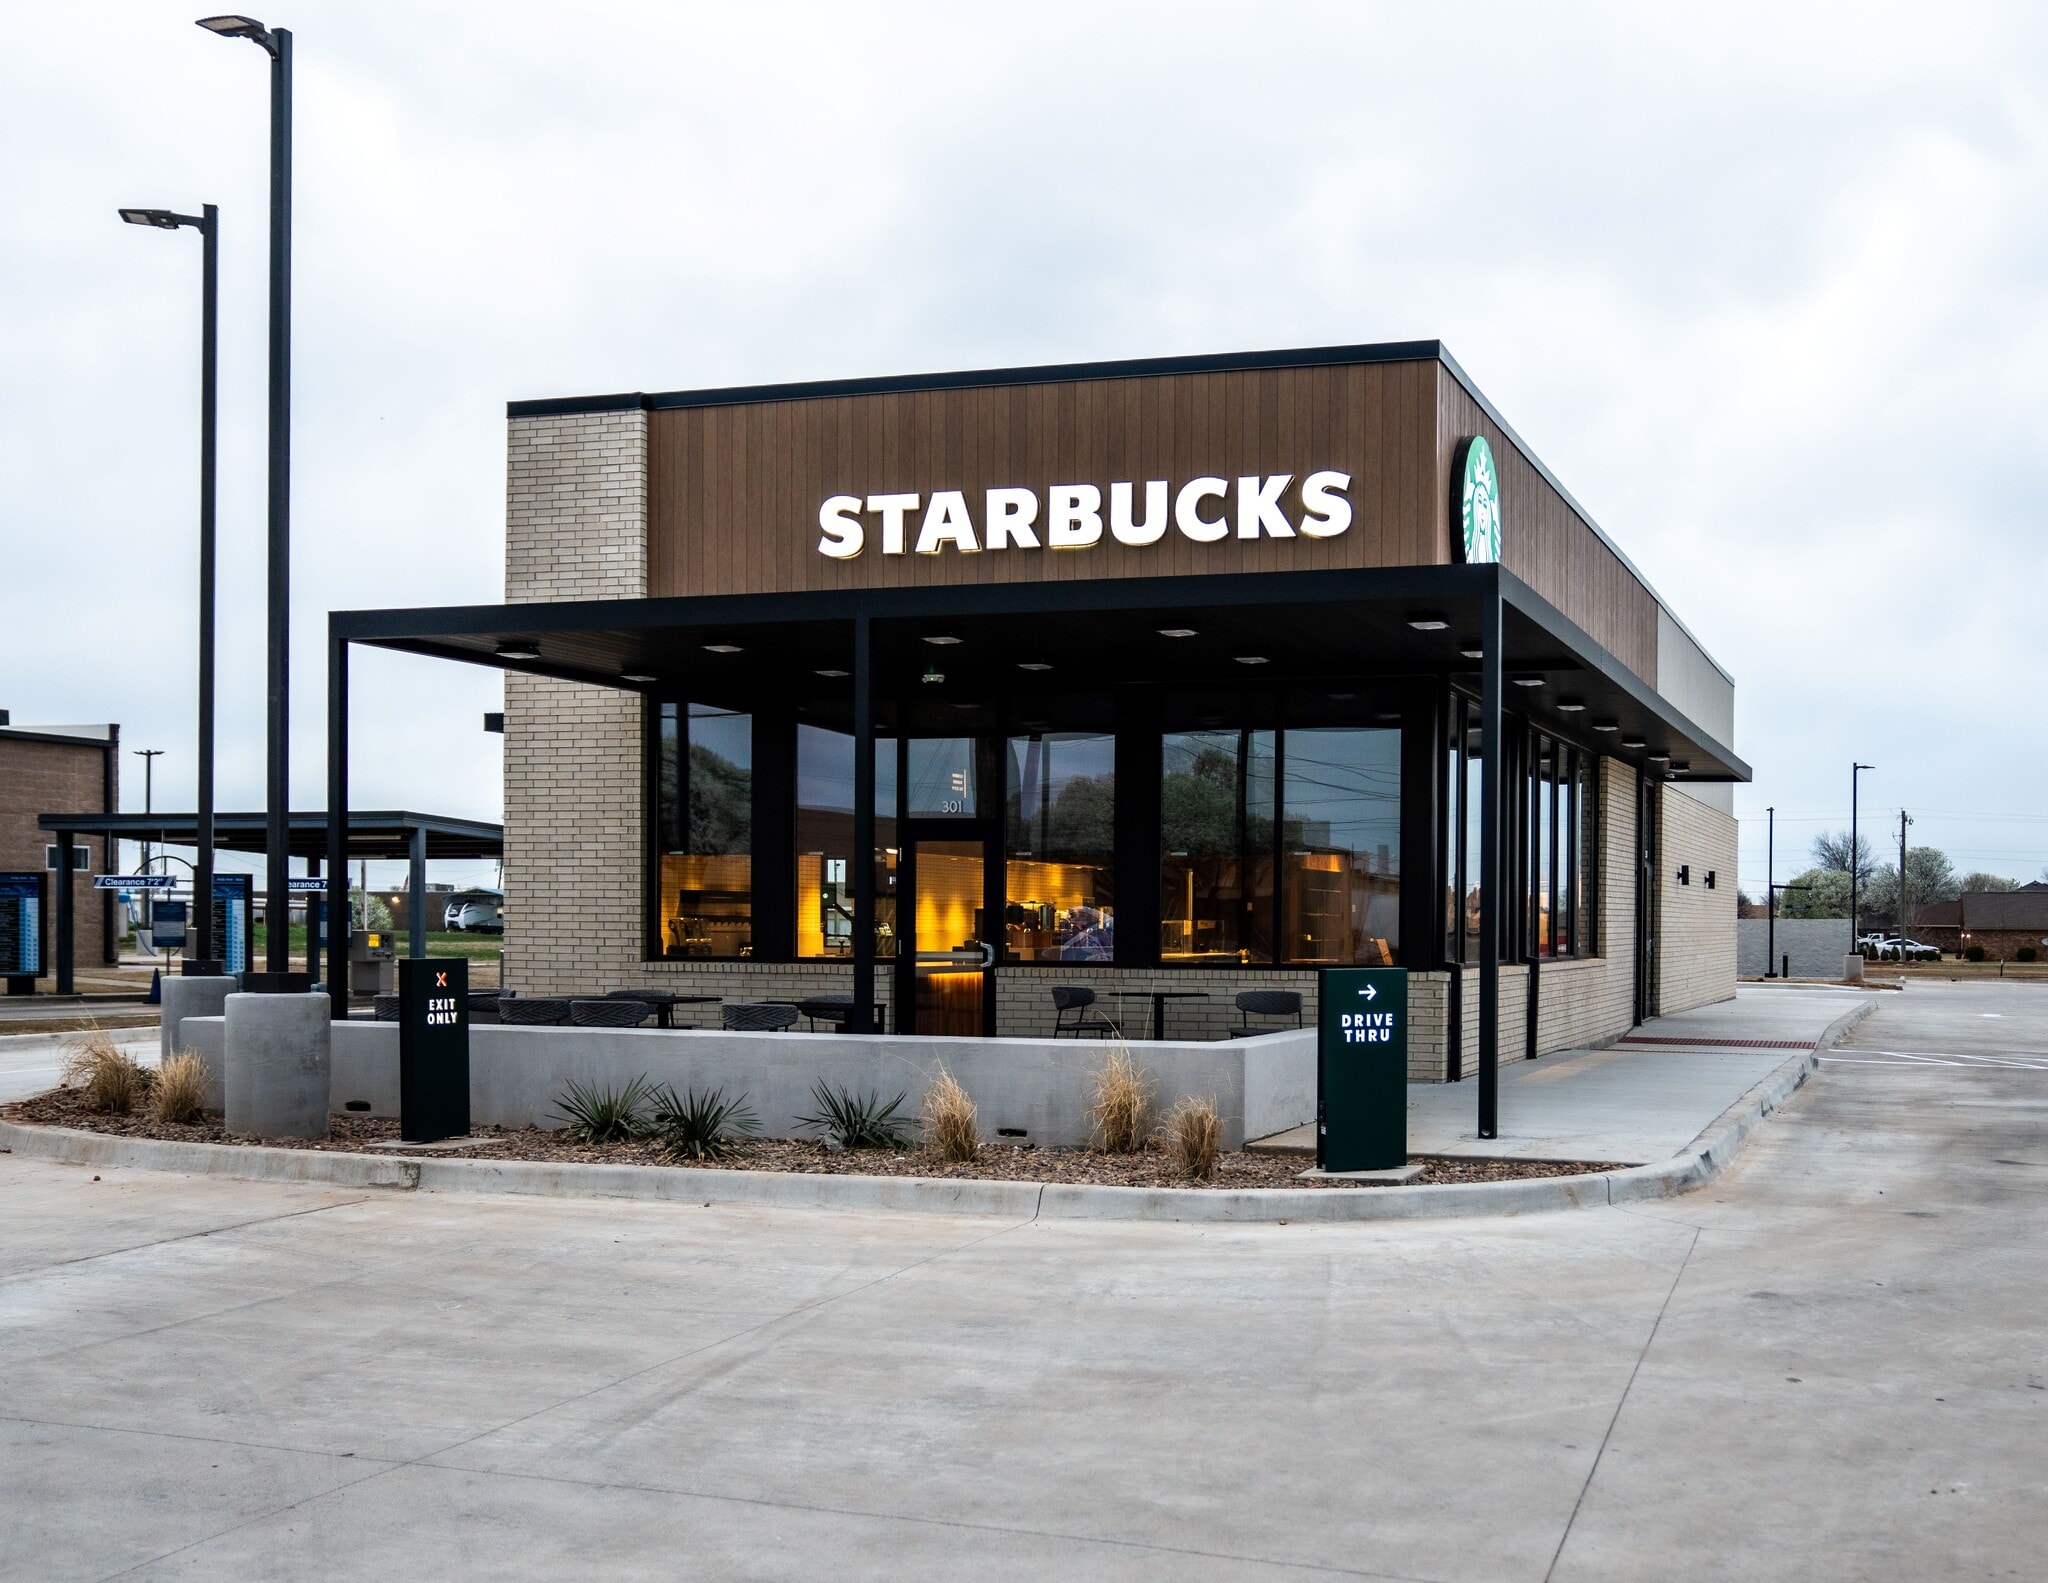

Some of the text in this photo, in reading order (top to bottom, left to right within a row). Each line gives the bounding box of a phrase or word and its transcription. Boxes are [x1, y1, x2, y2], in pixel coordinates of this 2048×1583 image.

[817, 470, 1353, 559] STARBUCKS
[942, 800, 962, 813] 301
[104, 878, 145, 886] Clearance
[288, 880, 320, 889] earance
[428, 998, 455, 1011] EXIT
[427, 1011, 458, 1025] ONLY
[1341, 1013, 1394, 1028] DRIVE
[1344, 1028, 1390, 1043] THRU
